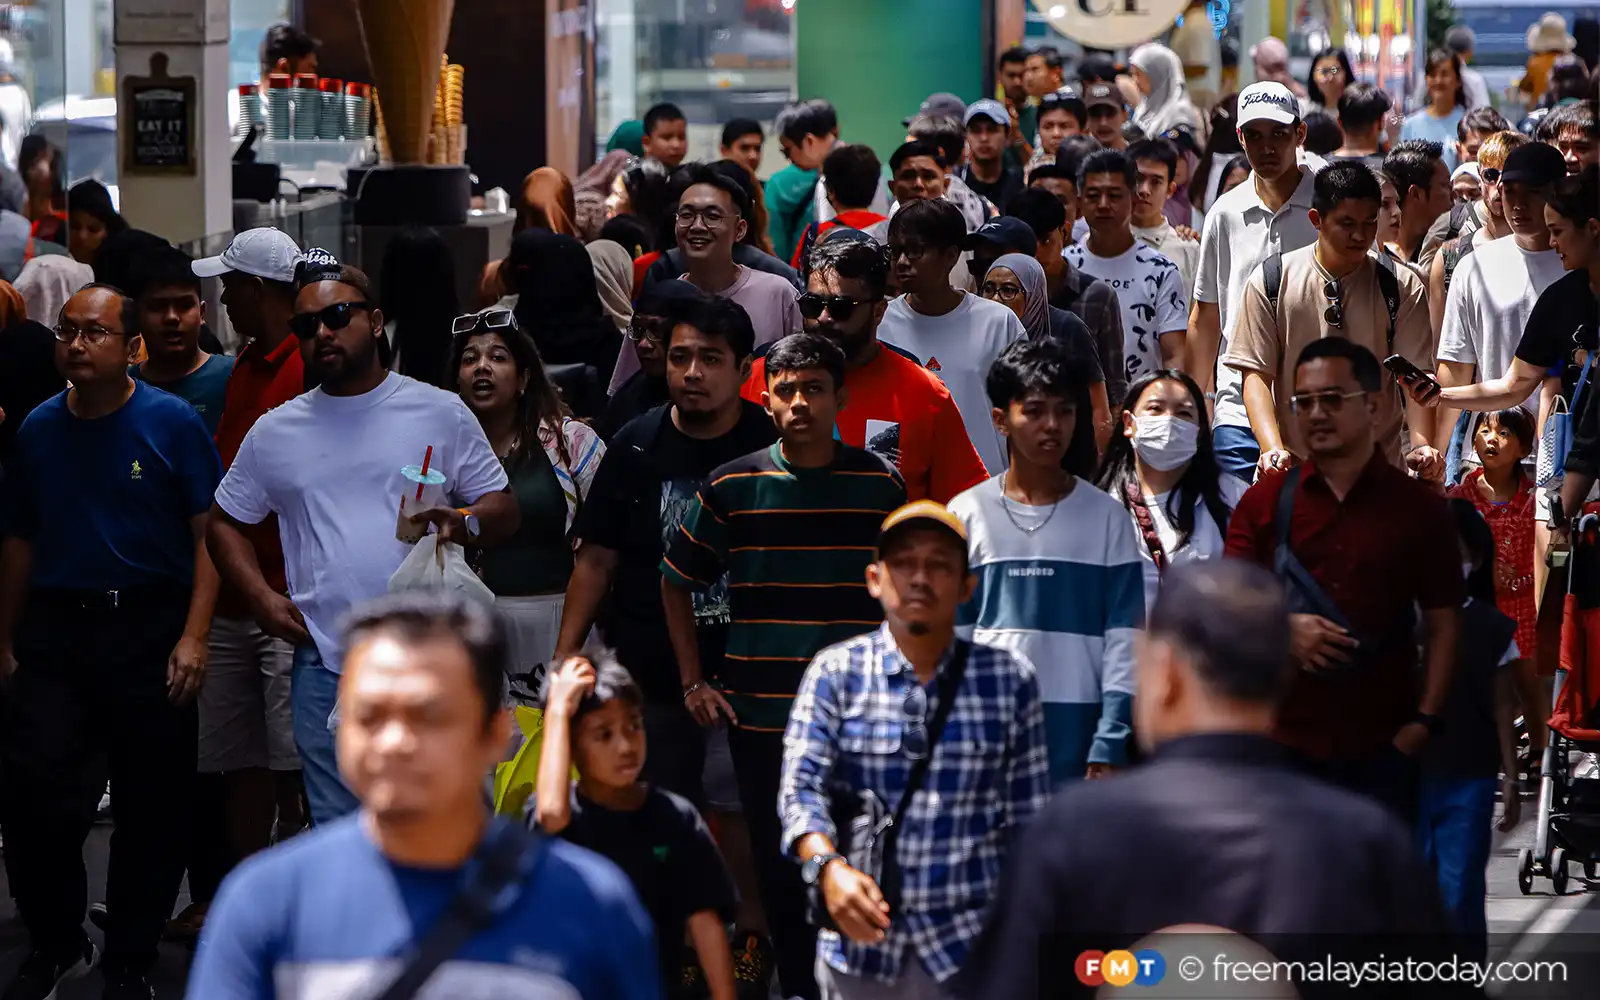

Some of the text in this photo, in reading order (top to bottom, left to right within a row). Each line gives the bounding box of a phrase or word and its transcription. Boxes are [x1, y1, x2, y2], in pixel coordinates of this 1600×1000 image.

[1241, 92, 1288, 110] Titleist
[138, 120, 181, 132] EAT IT
[1008, 567, 1055, 577] INSPIRED
